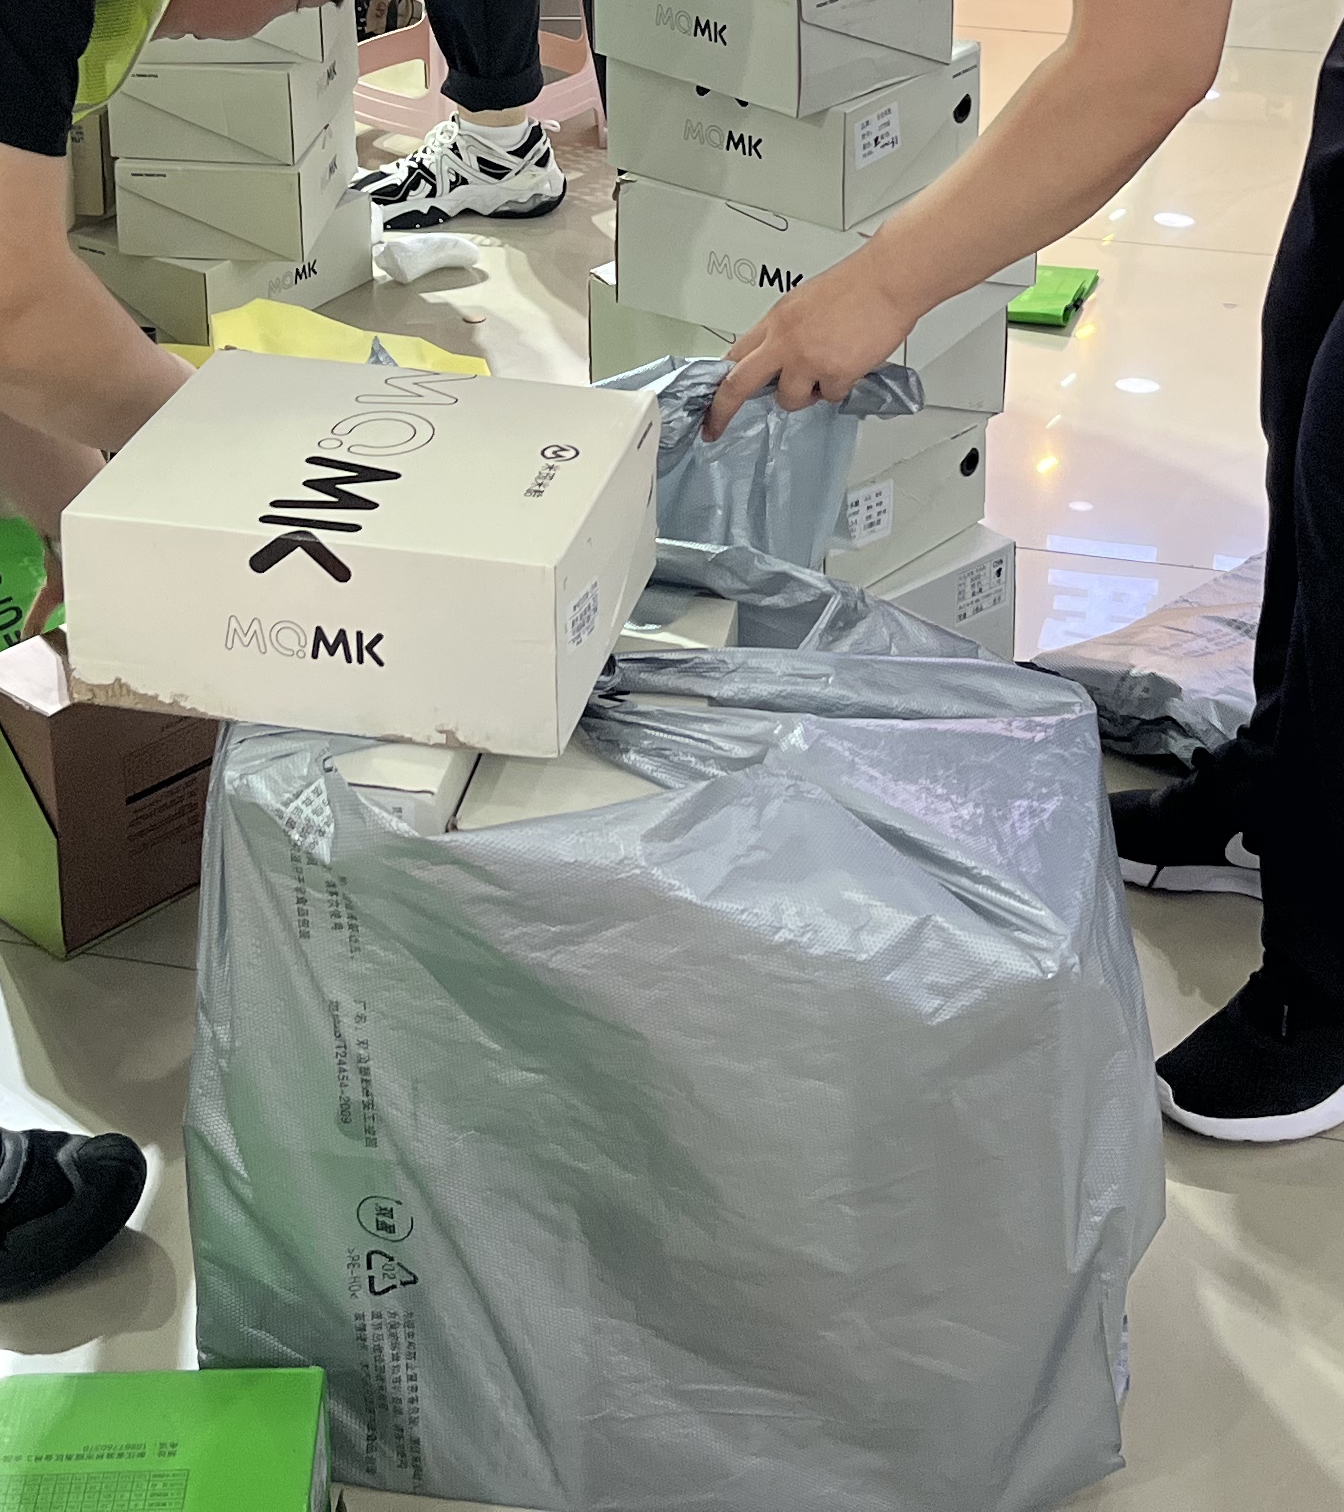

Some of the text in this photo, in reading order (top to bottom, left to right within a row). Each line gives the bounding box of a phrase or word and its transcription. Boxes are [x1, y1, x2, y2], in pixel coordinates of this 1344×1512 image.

[656, 3, 727, 46] MQMK
[684, 117, 763, 161] MQMK
[268, 258, 318, 300] MQMK
[707, 249, 807, 293] MQMK
[224, 616, 386, 668] MQMK
